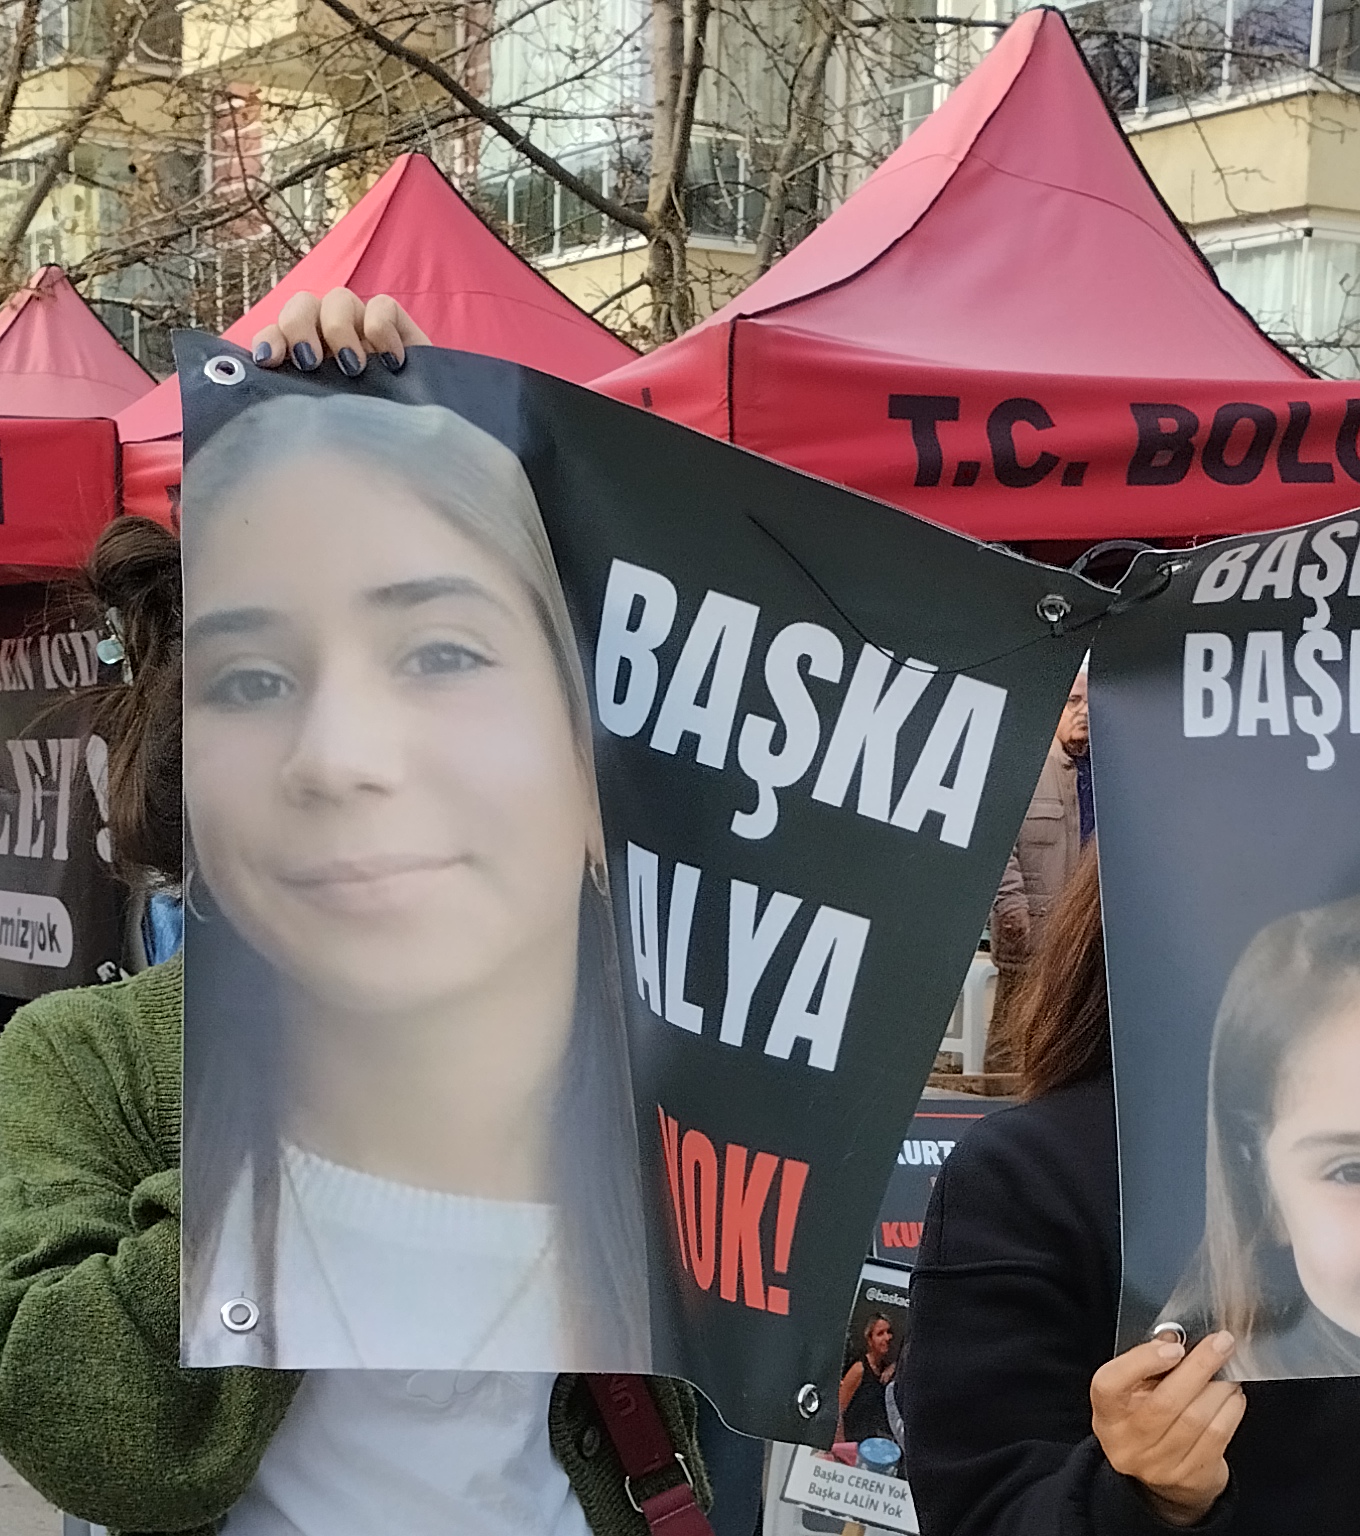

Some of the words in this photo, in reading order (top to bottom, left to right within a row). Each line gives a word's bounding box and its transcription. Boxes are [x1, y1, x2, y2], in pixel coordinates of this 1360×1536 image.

[888, 394, 1090, 487] T.C.
[594, 557, 1008, 850] BAŞKA
[626, 841, 871, 1073] ALYA
[657, 1102, 810, 1315] YOK!
[808, 1482, 841, 1501] Başka
[843, 1491, 880, 1512] LALİN
[882, 1501, 903, 1519] Yok
[813, 1465, 845, 1484] Başka
[847, 1475, 885, 1495] CEREN
[888, 1485, 908, 1501] Yok
